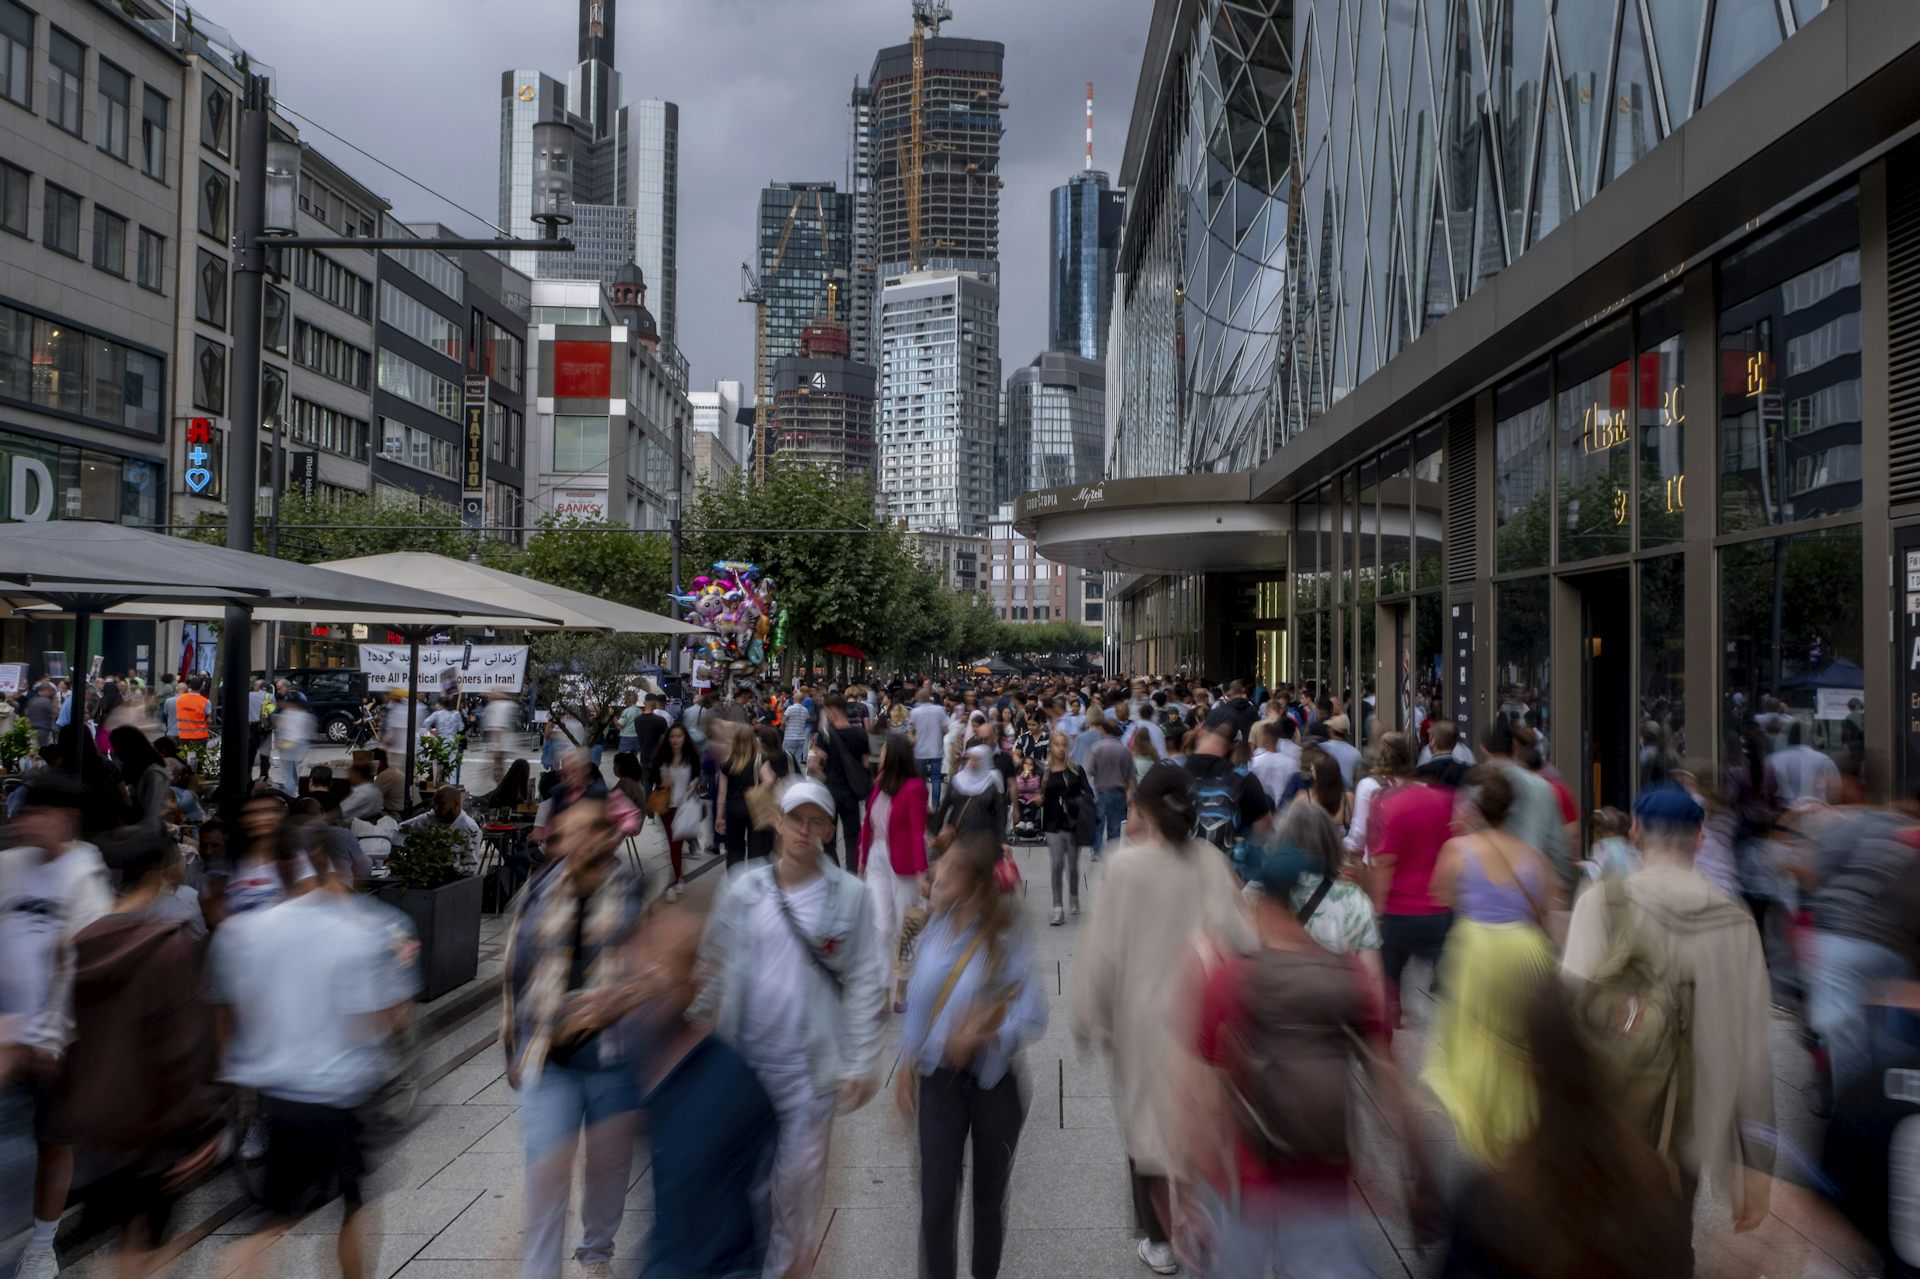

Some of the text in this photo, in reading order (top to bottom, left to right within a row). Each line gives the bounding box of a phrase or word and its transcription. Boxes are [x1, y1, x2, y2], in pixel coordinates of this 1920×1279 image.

[468, 409, 481, 487] TATTOO
[10, 455, 54, 522] D
[556, 503, 604, 514] BANKSY
[388, 672, 400, 683] All
[402, 672, 437, 684] Ptical
[484, 673, 492, 684] in
[495, 673, 515, 684] Iran!
